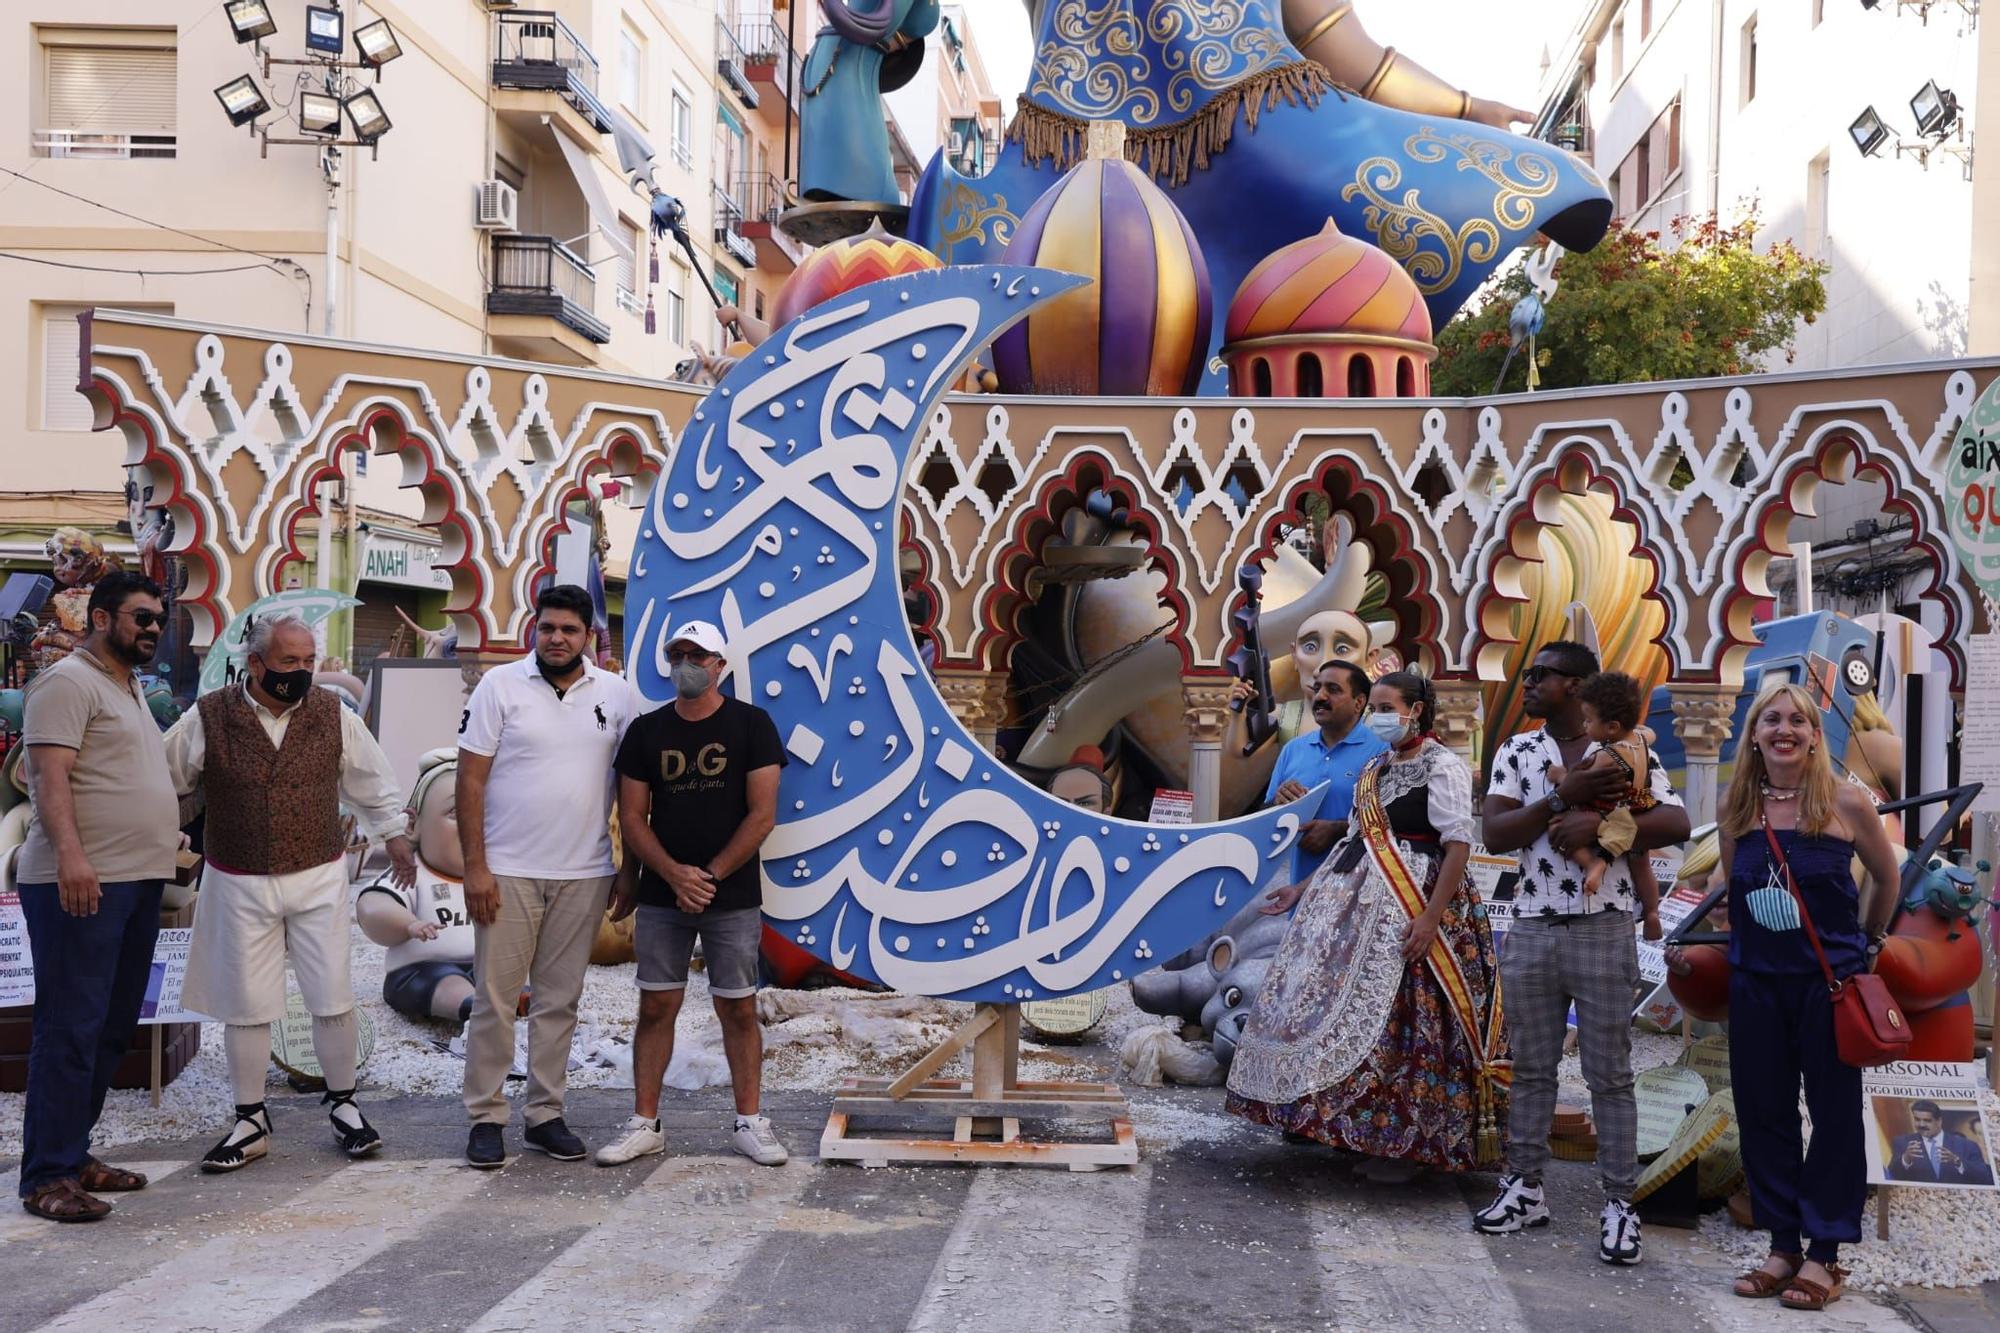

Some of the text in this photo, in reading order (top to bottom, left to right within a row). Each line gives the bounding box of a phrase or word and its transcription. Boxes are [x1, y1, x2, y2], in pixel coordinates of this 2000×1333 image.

[365, 542, 408, 577] ANAHÍ
[1864, 1085, 1977, 1099] OGO BOLIVARIANO!
